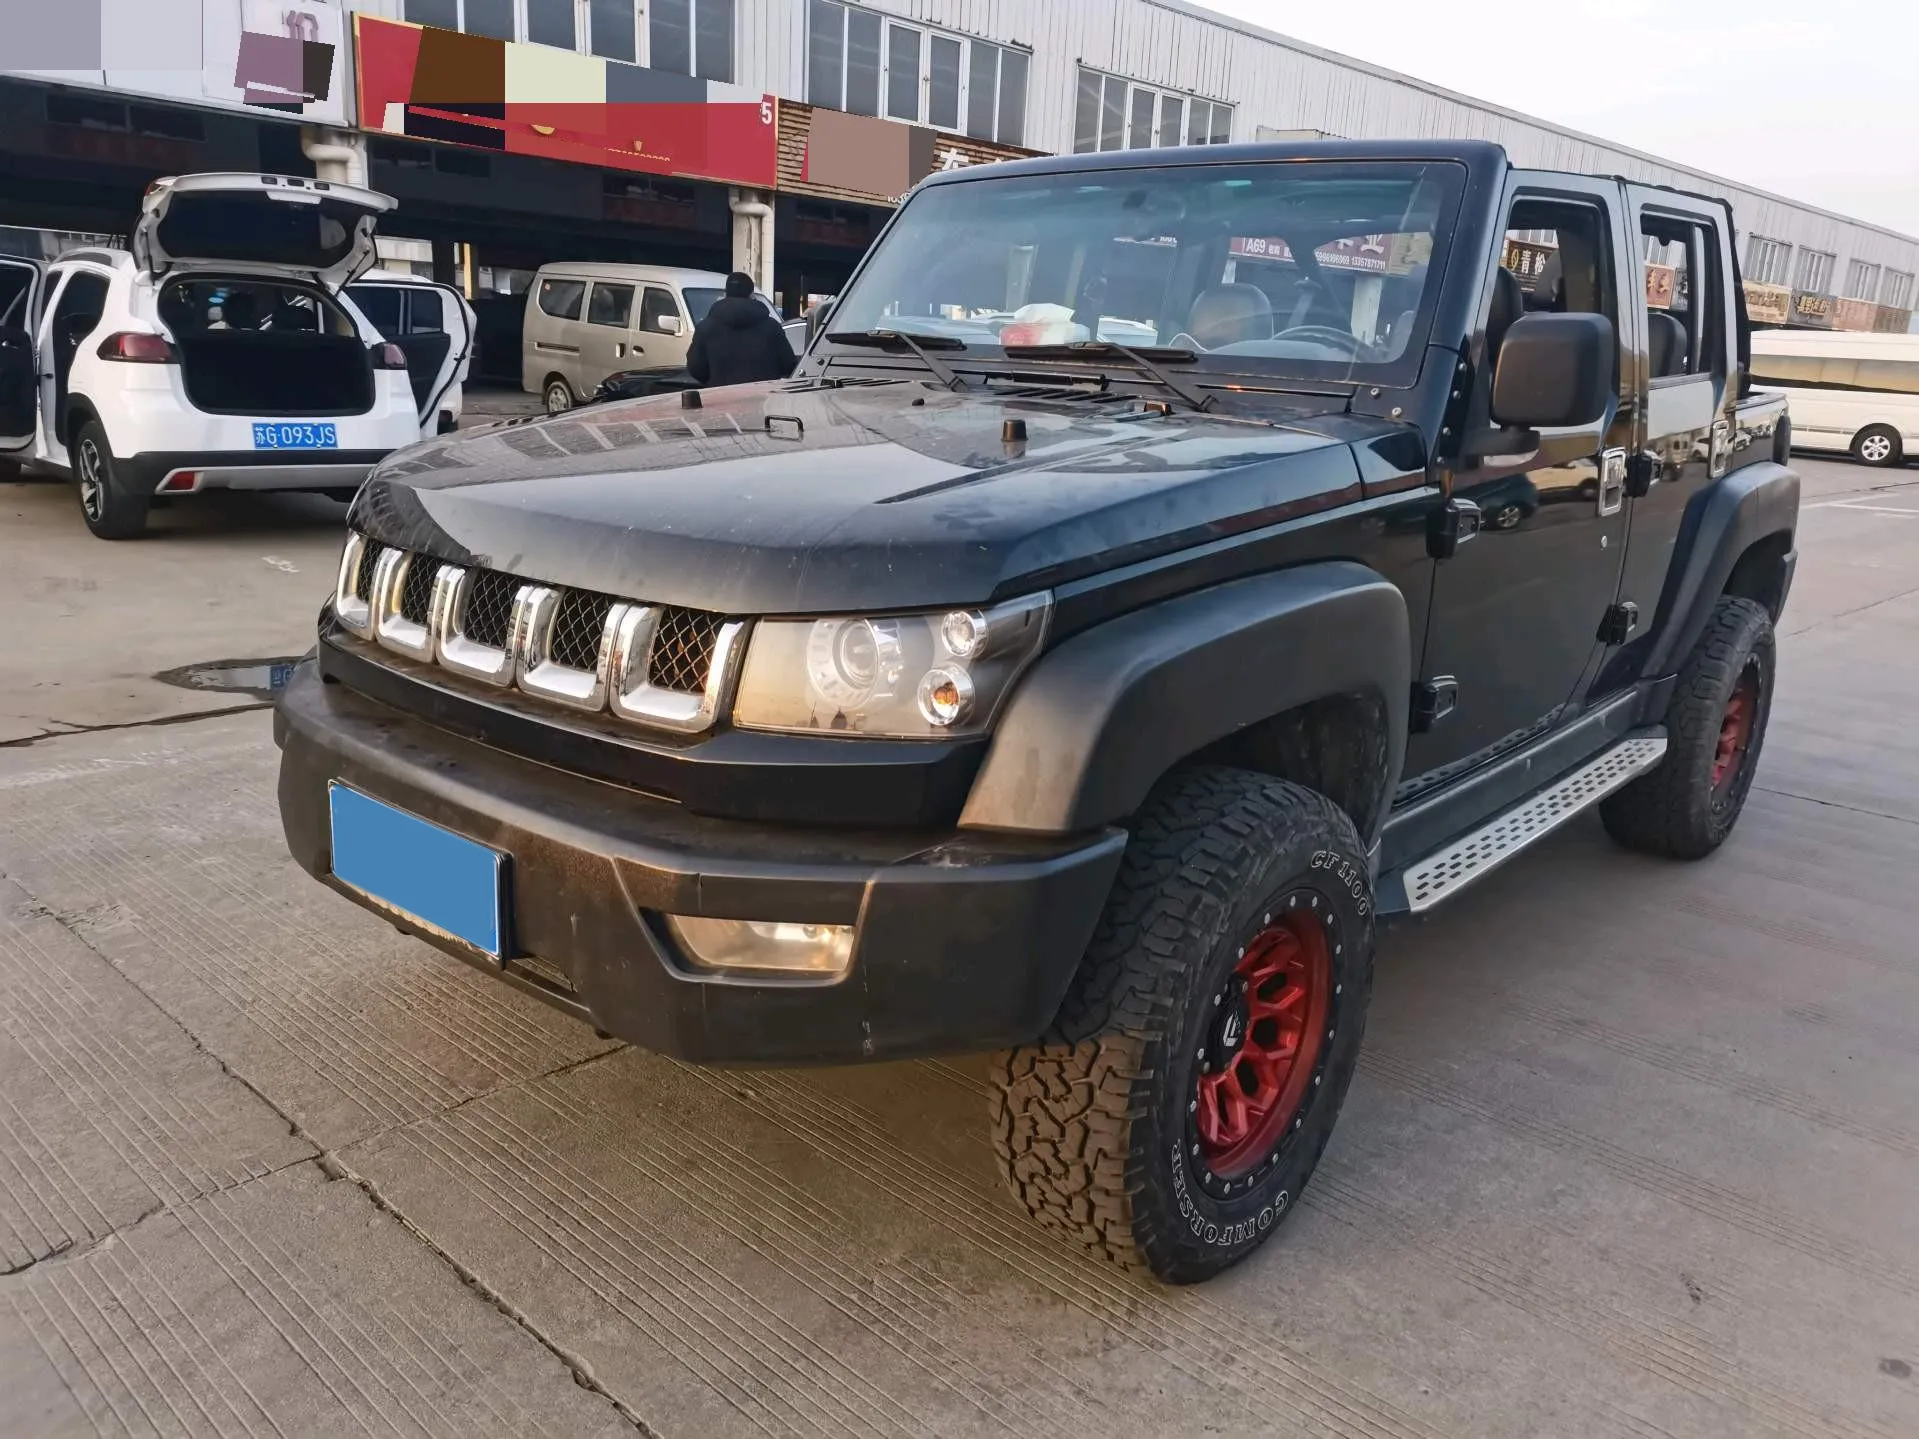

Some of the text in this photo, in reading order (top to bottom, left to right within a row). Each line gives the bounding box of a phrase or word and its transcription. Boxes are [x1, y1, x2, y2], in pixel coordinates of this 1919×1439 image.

[1245, 238, 1266, 253] A69
[1311, 850, 1369, 916] CF 1100
[1171, 1138, 1289, 1246] COMFORSER
